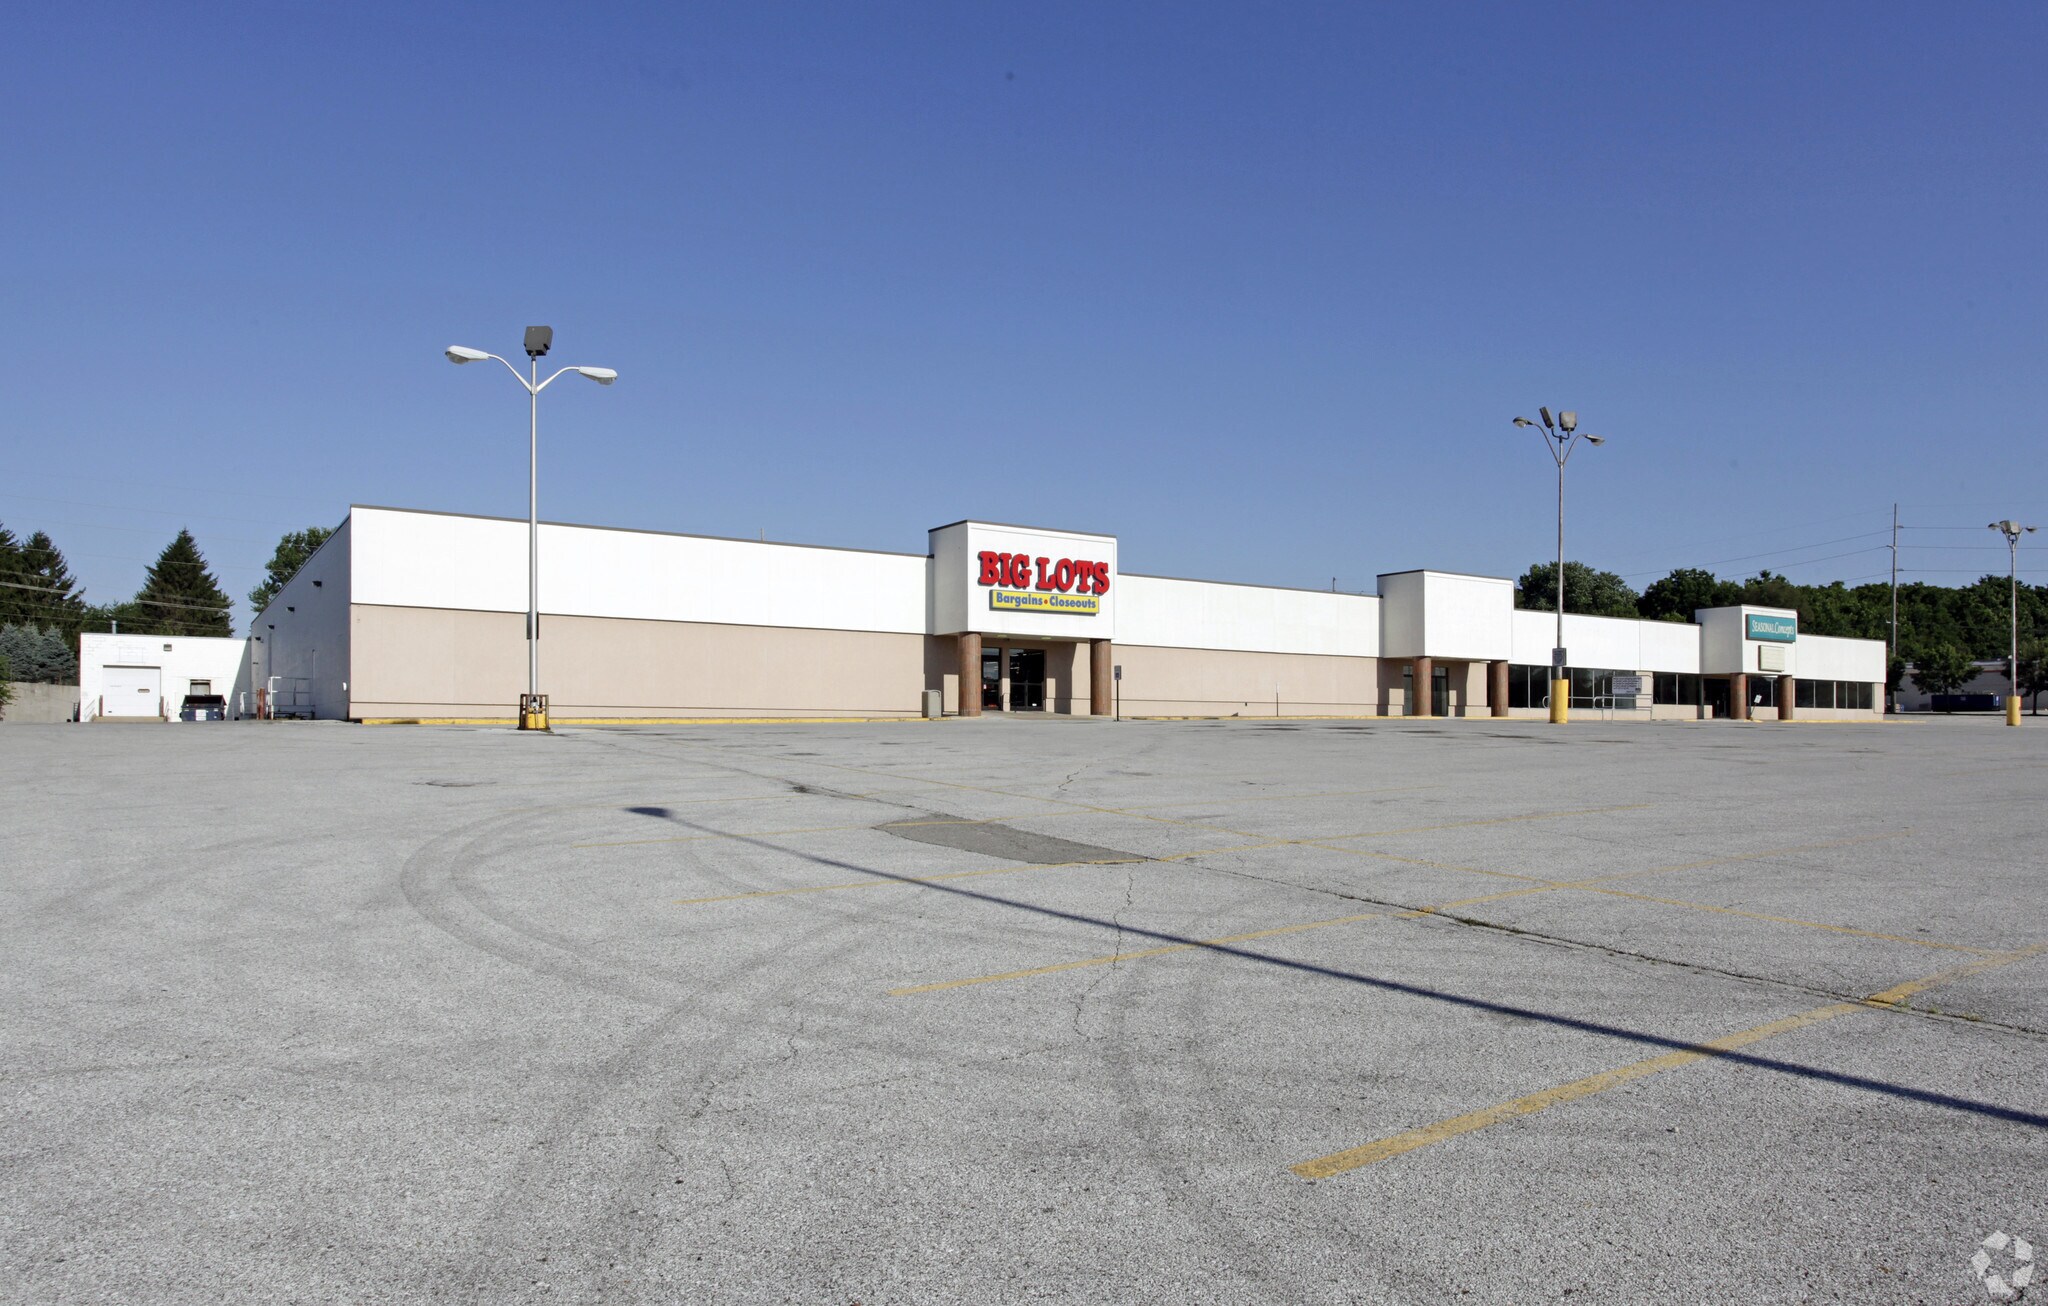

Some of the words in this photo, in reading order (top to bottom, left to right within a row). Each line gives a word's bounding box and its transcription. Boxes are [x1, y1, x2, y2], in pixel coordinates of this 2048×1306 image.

[978, 551, 1032, 588] BIG
[1036, 557, 1110, 595] LOTS
[996, 592, 1043, 607] Bargains
[1050, 595, 1096, 608] Closeouts
